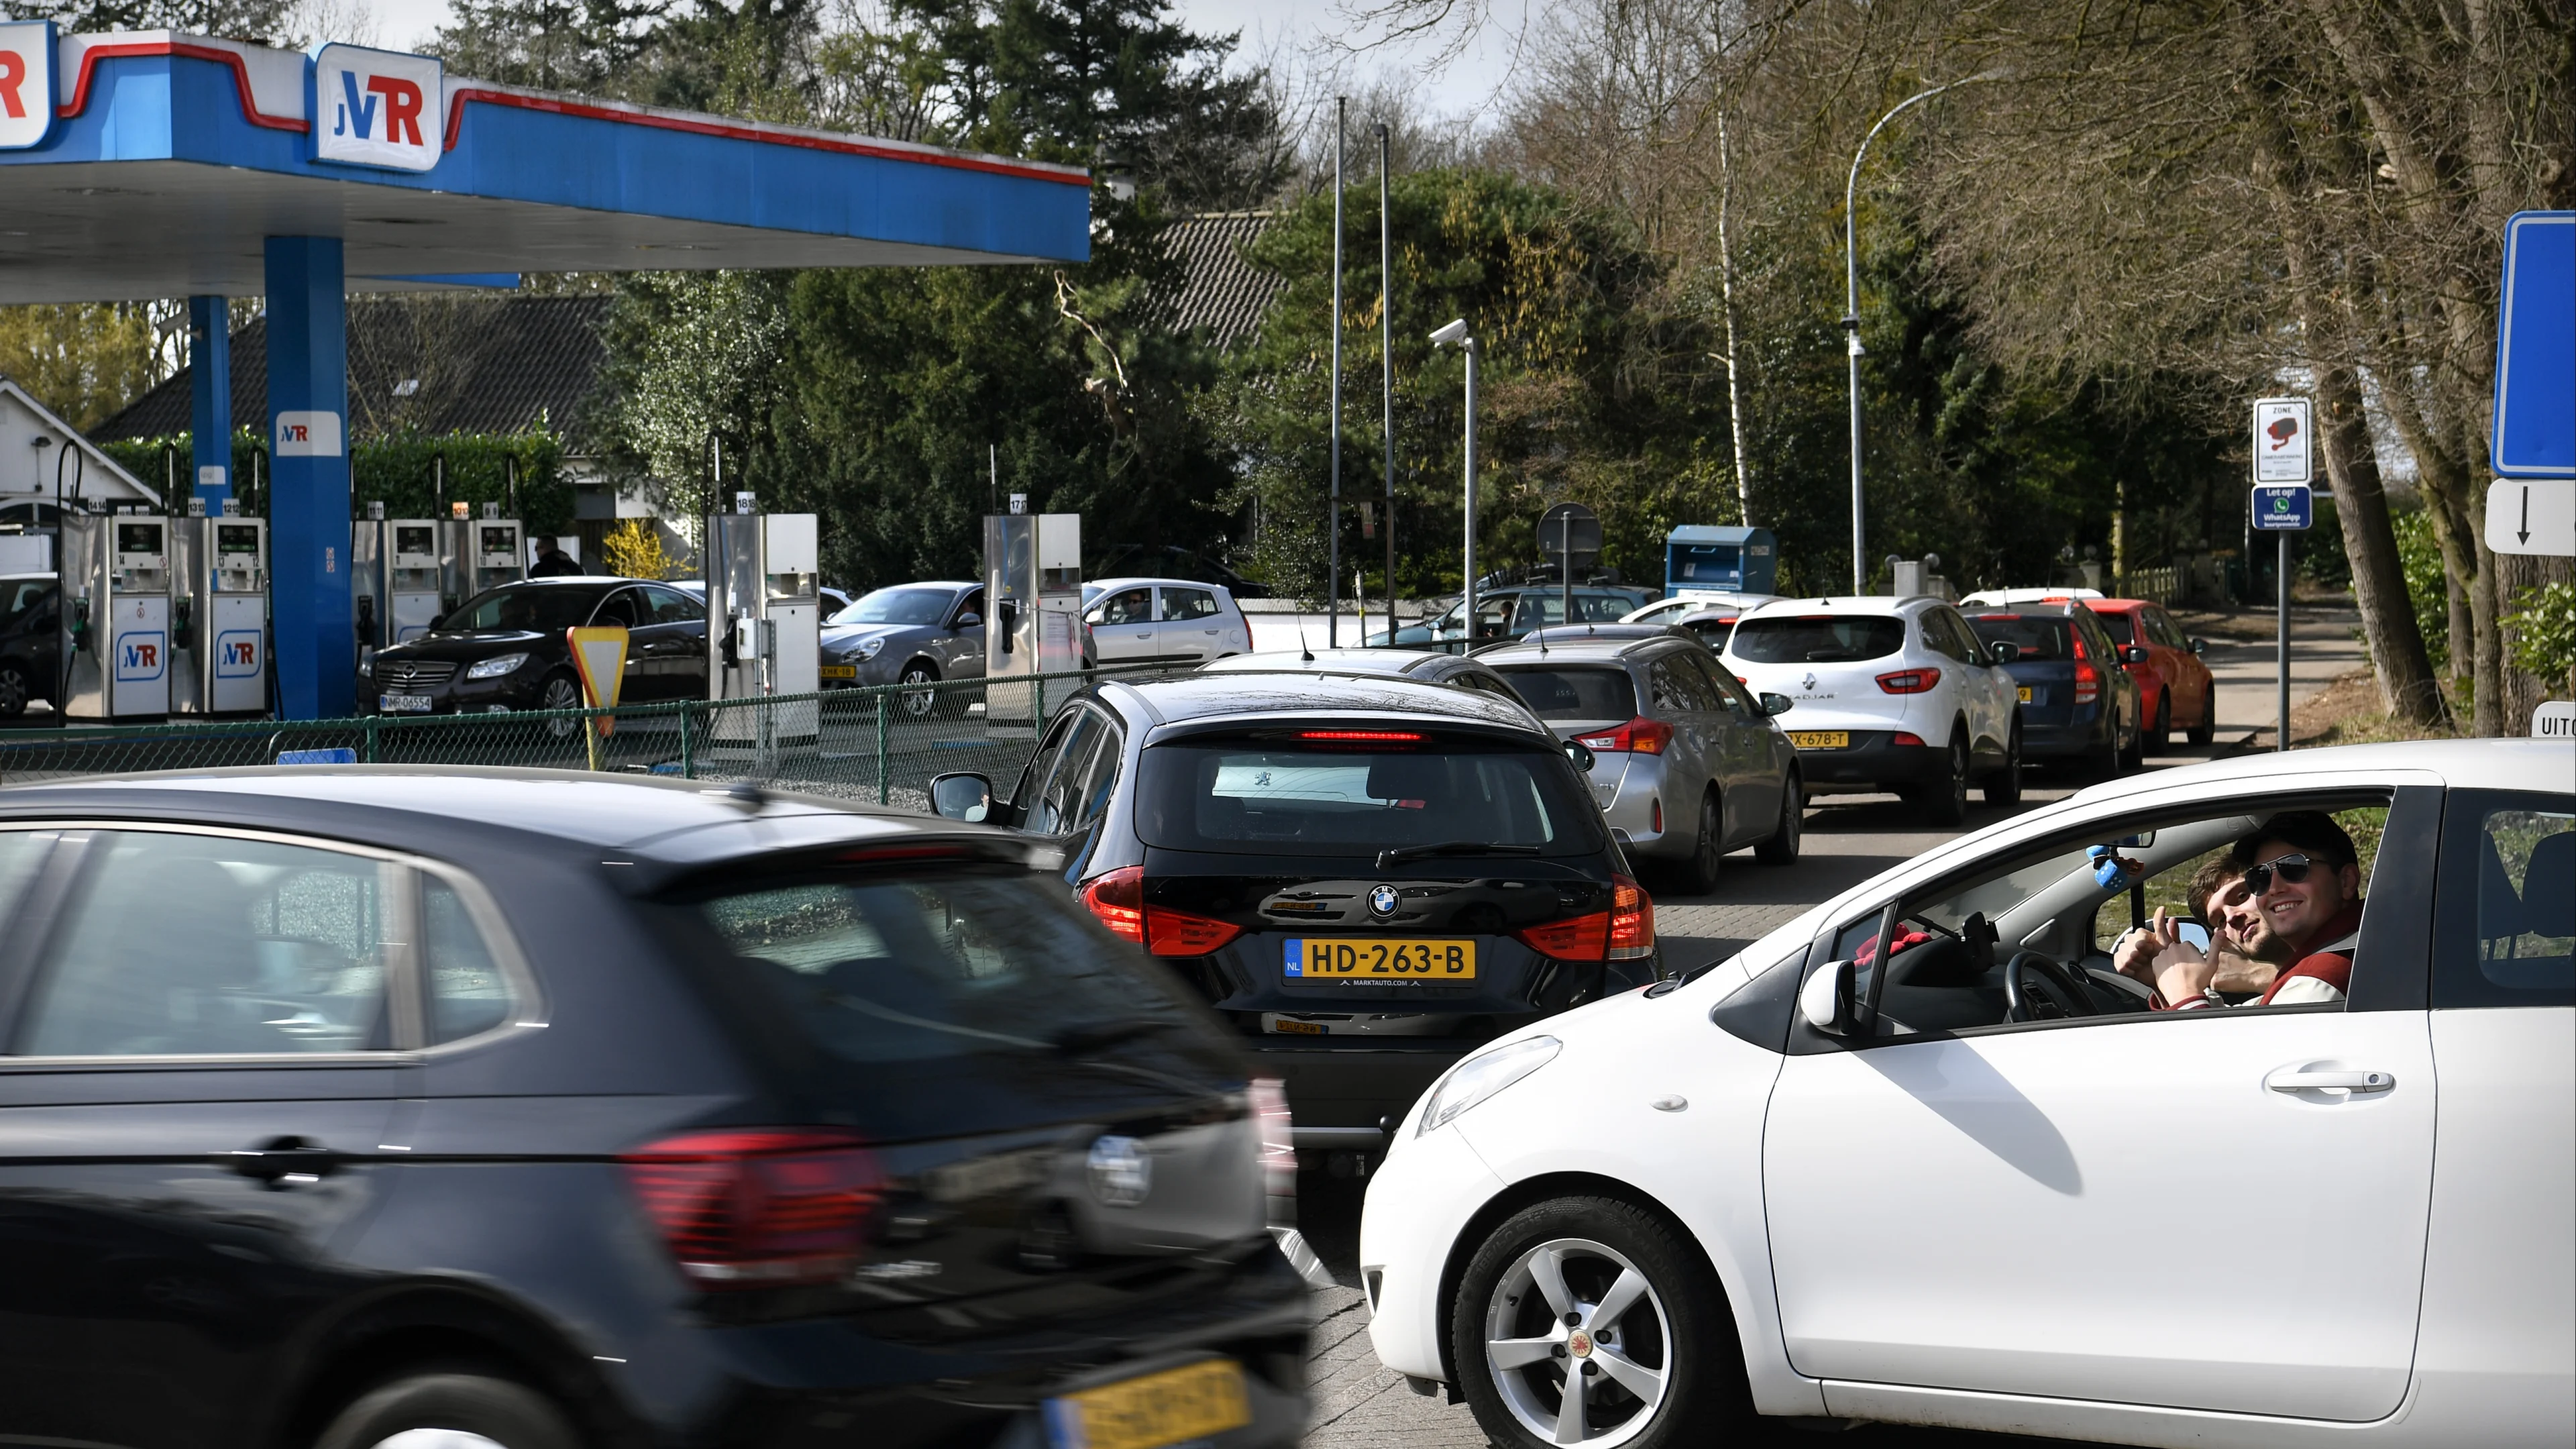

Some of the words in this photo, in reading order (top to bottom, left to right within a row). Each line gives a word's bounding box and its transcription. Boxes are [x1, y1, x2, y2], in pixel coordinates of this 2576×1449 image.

[2267, 488, 2281, 496] Let
[2282, 488, 2296, 498] op!
[89, 501, 97, 510] 14
[98, 501, 106, 510] 14
[189, 503, 197, 512] 13
[738, 498, 747, 508] 18
[1011, 500, 1020, 508] 17
[223, 504, 232, 513] 12
[233, 504, 239, 513] 12
[119, 555, 125, 566] 14
[403, 698, 429, 708] 06554
[1373, 887, 1397, 897] BMW
[1287, 963, 1300, 971] NL
[1312, 945, 1464, 973] HD-263-B
